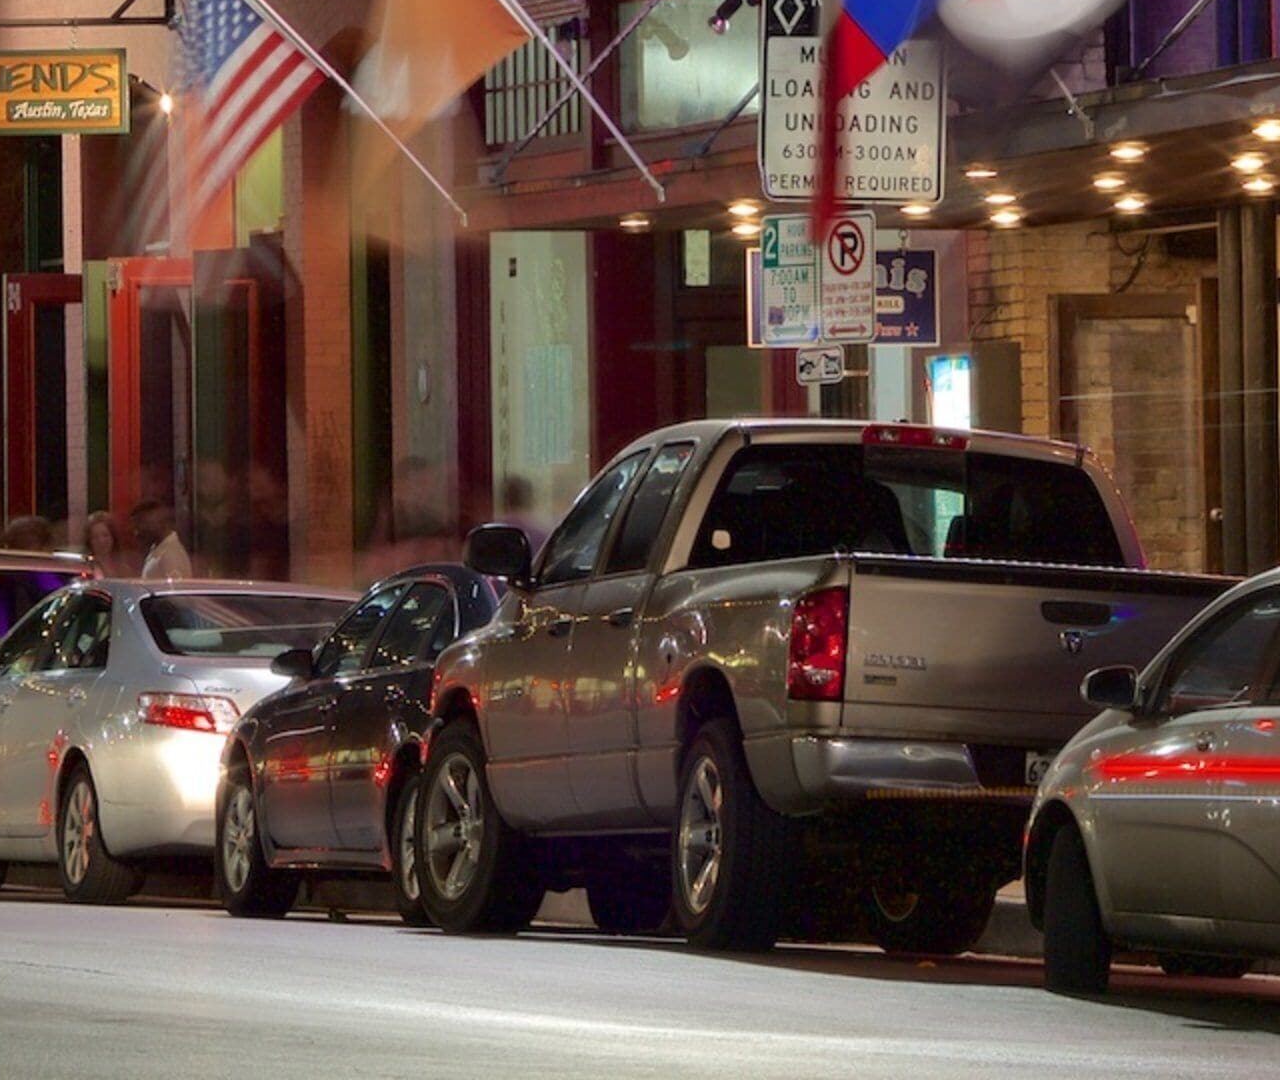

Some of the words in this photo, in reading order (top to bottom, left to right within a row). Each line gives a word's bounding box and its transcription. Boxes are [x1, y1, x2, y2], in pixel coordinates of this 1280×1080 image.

[770, 79, 871, 100] LOAG
[889, 81, 935, 101] AND
[13, 100, 67, 120] Austin,
[69, 99, 109, 119] Texas
[769, 174, 830, 191] PERM
[845, 175, 933, 192] REQUIRED
[764, 226, 777, 259] 2
